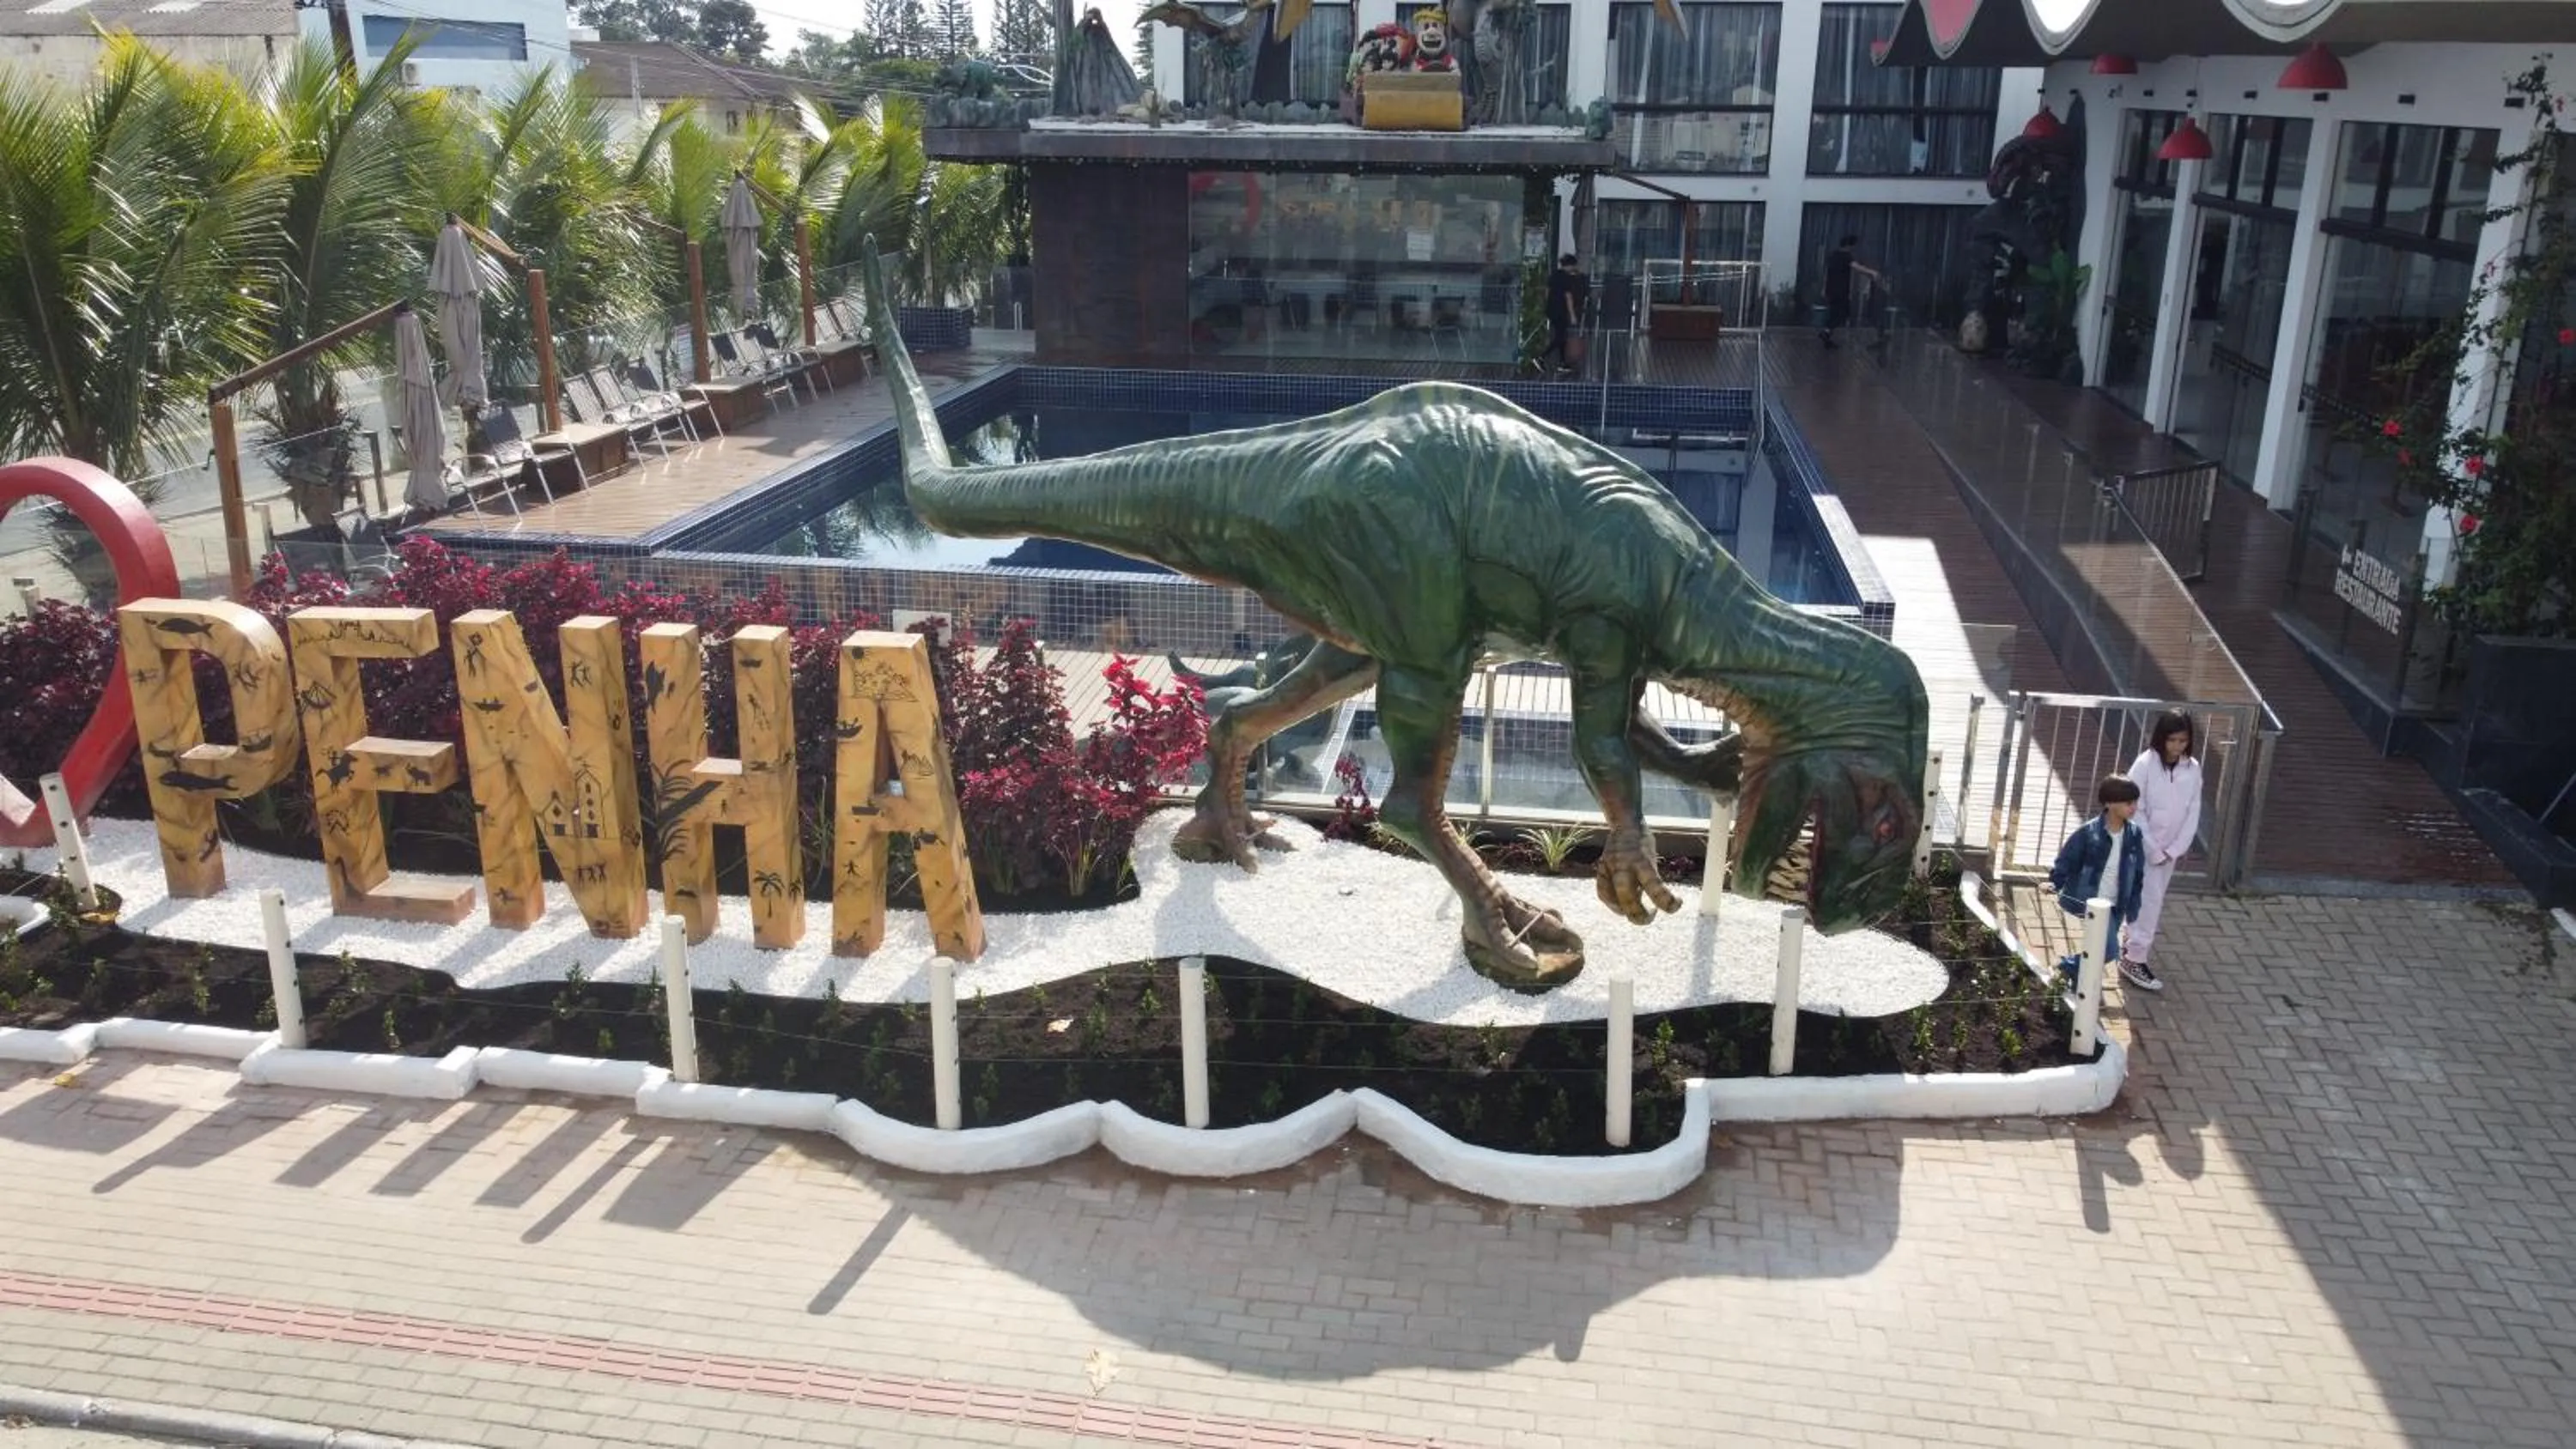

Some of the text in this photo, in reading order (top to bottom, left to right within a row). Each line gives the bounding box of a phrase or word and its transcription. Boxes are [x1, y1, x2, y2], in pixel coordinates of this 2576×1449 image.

[2335, 567, 2402, 634] RESTAURANTE
[2353, 549, 2400, 601] ENTRADA
[118, 597, 986, 961] PENHA
